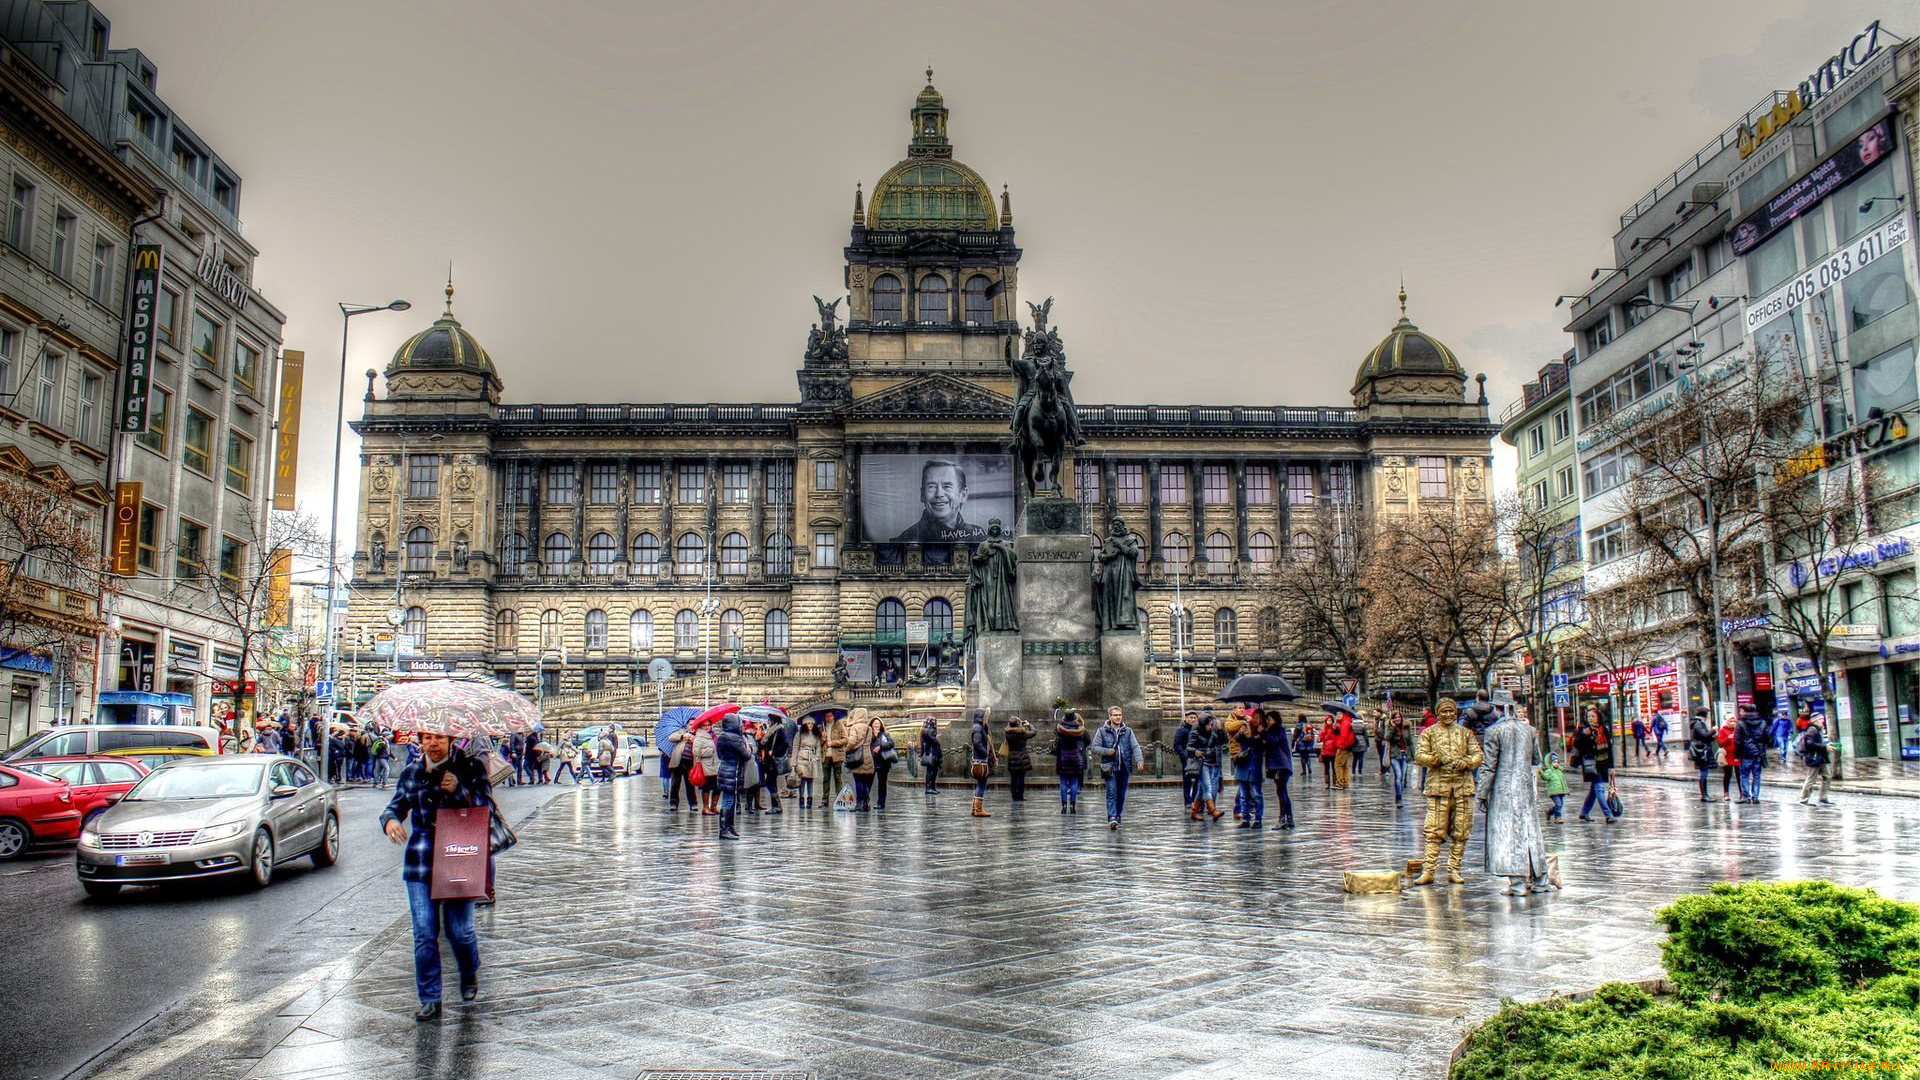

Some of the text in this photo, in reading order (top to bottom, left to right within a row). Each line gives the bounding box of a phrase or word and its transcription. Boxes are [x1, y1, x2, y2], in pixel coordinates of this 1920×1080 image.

[1887, 218, 1904, 236] FOR
[1888, 229, 1907, 249] RENT
[1748, 231, 1883, 326] OFFICES 605 083 611
[126, 279, 154, 430] McDonald's
[116, 490, 135, 572] HOTEL
[940, 529, 971, 540] HAVEL
